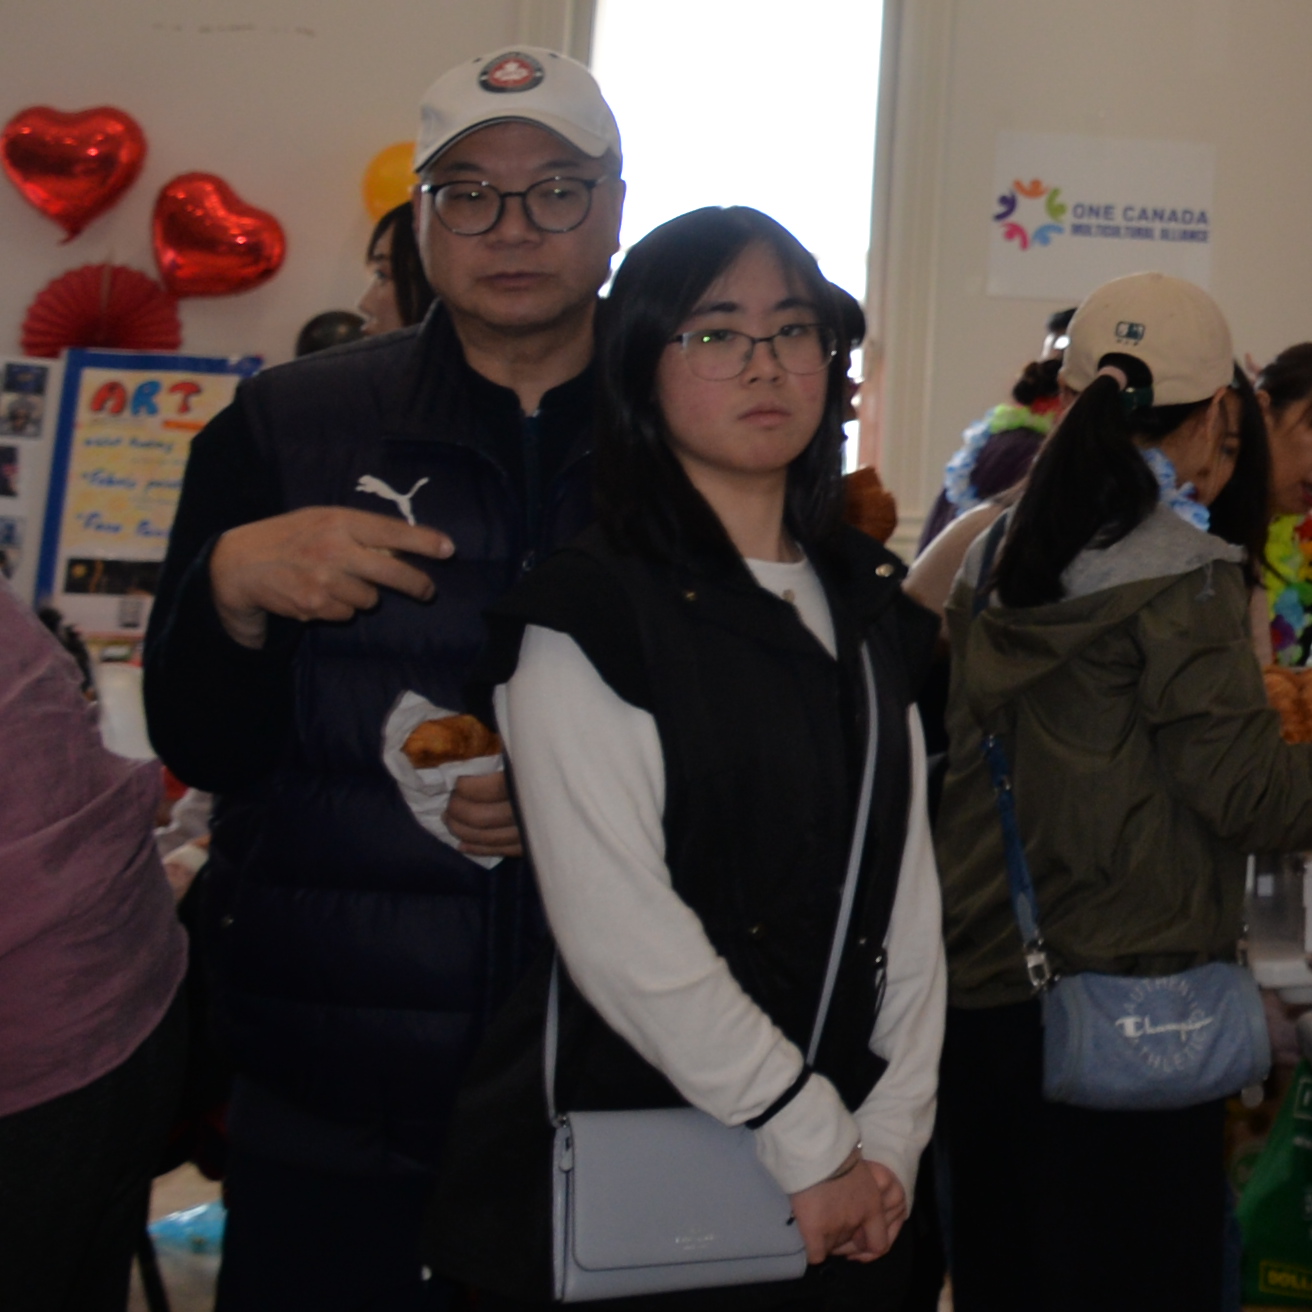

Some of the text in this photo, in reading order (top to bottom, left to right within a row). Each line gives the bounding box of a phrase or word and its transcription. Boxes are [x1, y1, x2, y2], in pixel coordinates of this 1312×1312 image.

[1072, 202, 1209, 225] ONE CANADA
[90, 379, 203, 416] ART
